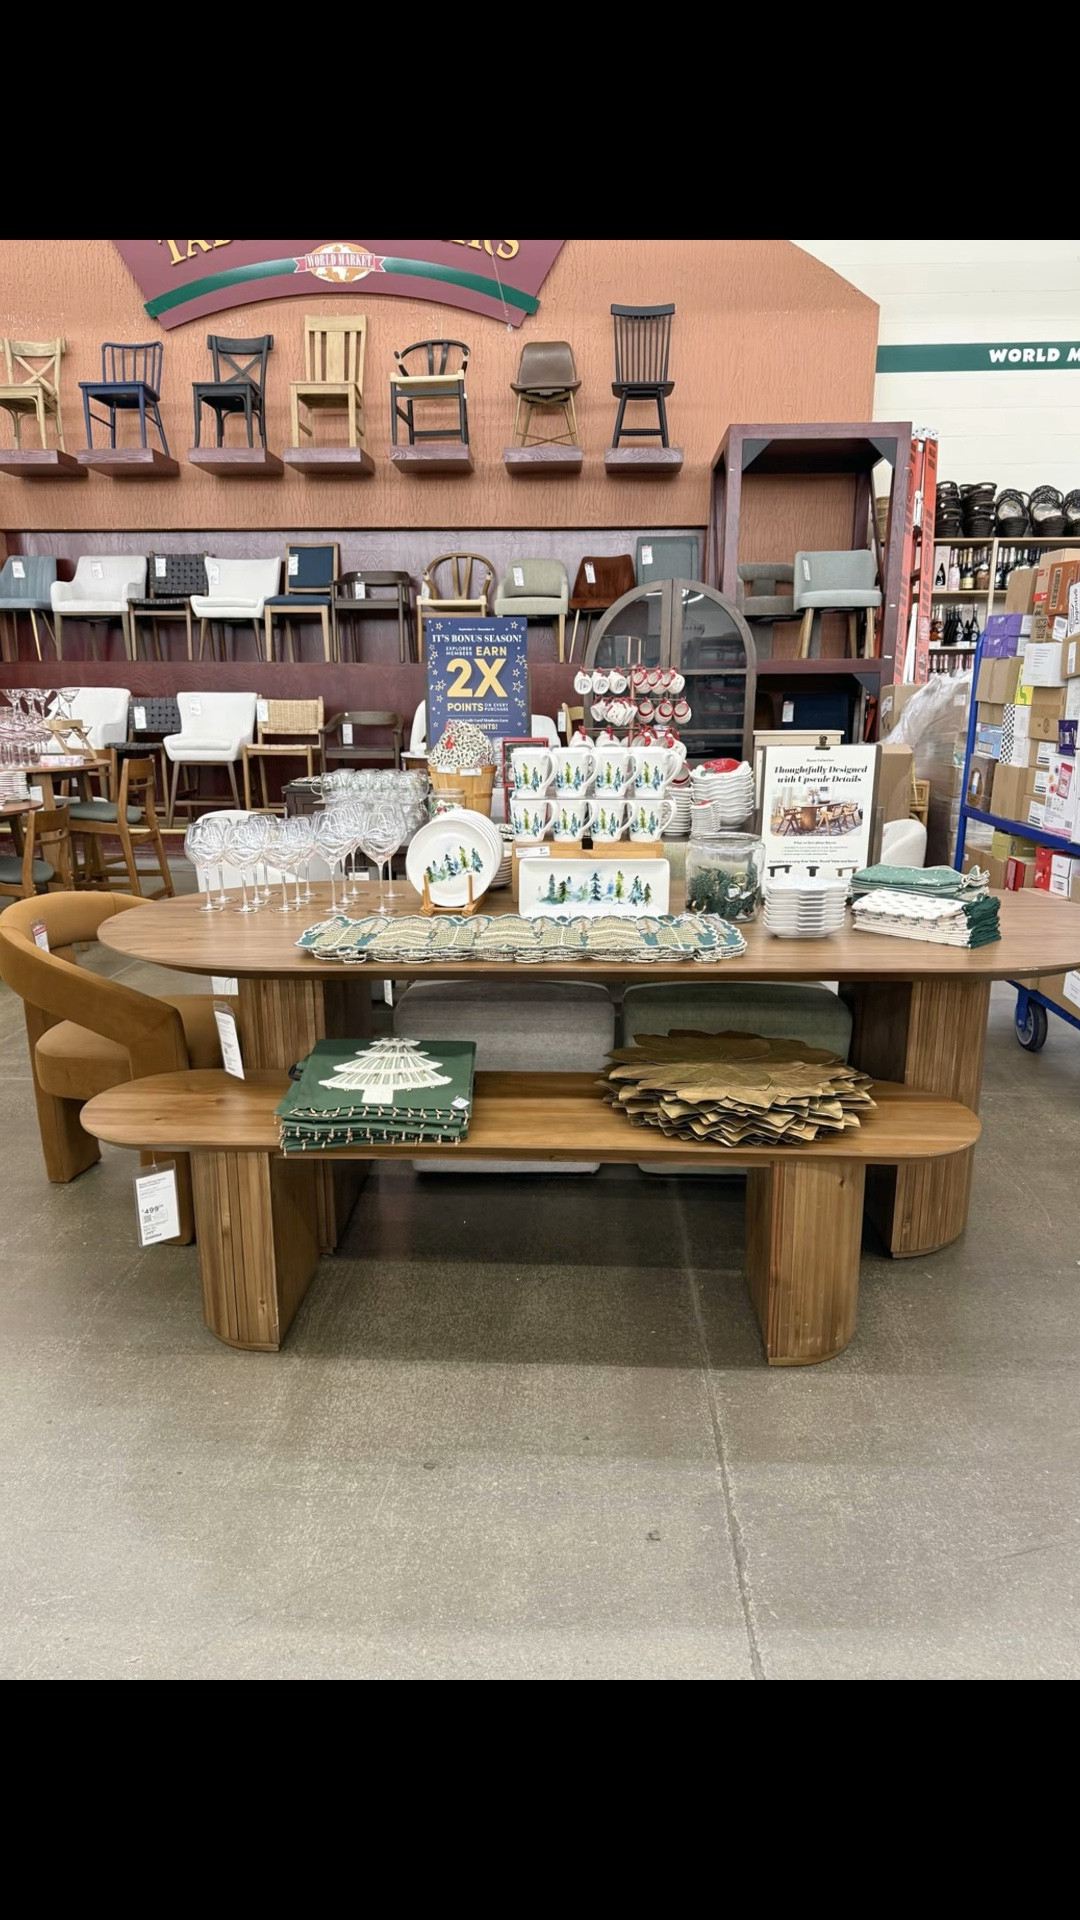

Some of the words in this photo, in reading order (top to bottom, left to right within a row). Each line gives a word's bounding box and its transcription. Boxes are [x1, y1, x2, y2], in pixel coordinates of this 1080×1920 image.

[307, 254, 336, 267] WORLD
[338, 253, 372, 267] MARKET
[989, 348, 1060, 363] WORLD
[432, 634, 450, 642] IT'S
[452, 634, 483, 642] BONUS
[484, 634, 522, 642] SEASON!
[475, 646, 507, 656] EARN
[446, 658, 508, 698] 2X
[447, 703, 484, 712] POINTS
[774, 765, 827, 775] Thoughtfully
[828, 765, 868, 774] Designed
[777, 775, 796, 783] with
[798, 775, 830, 784] Upscale
[832, 775, 861, 783] Details
